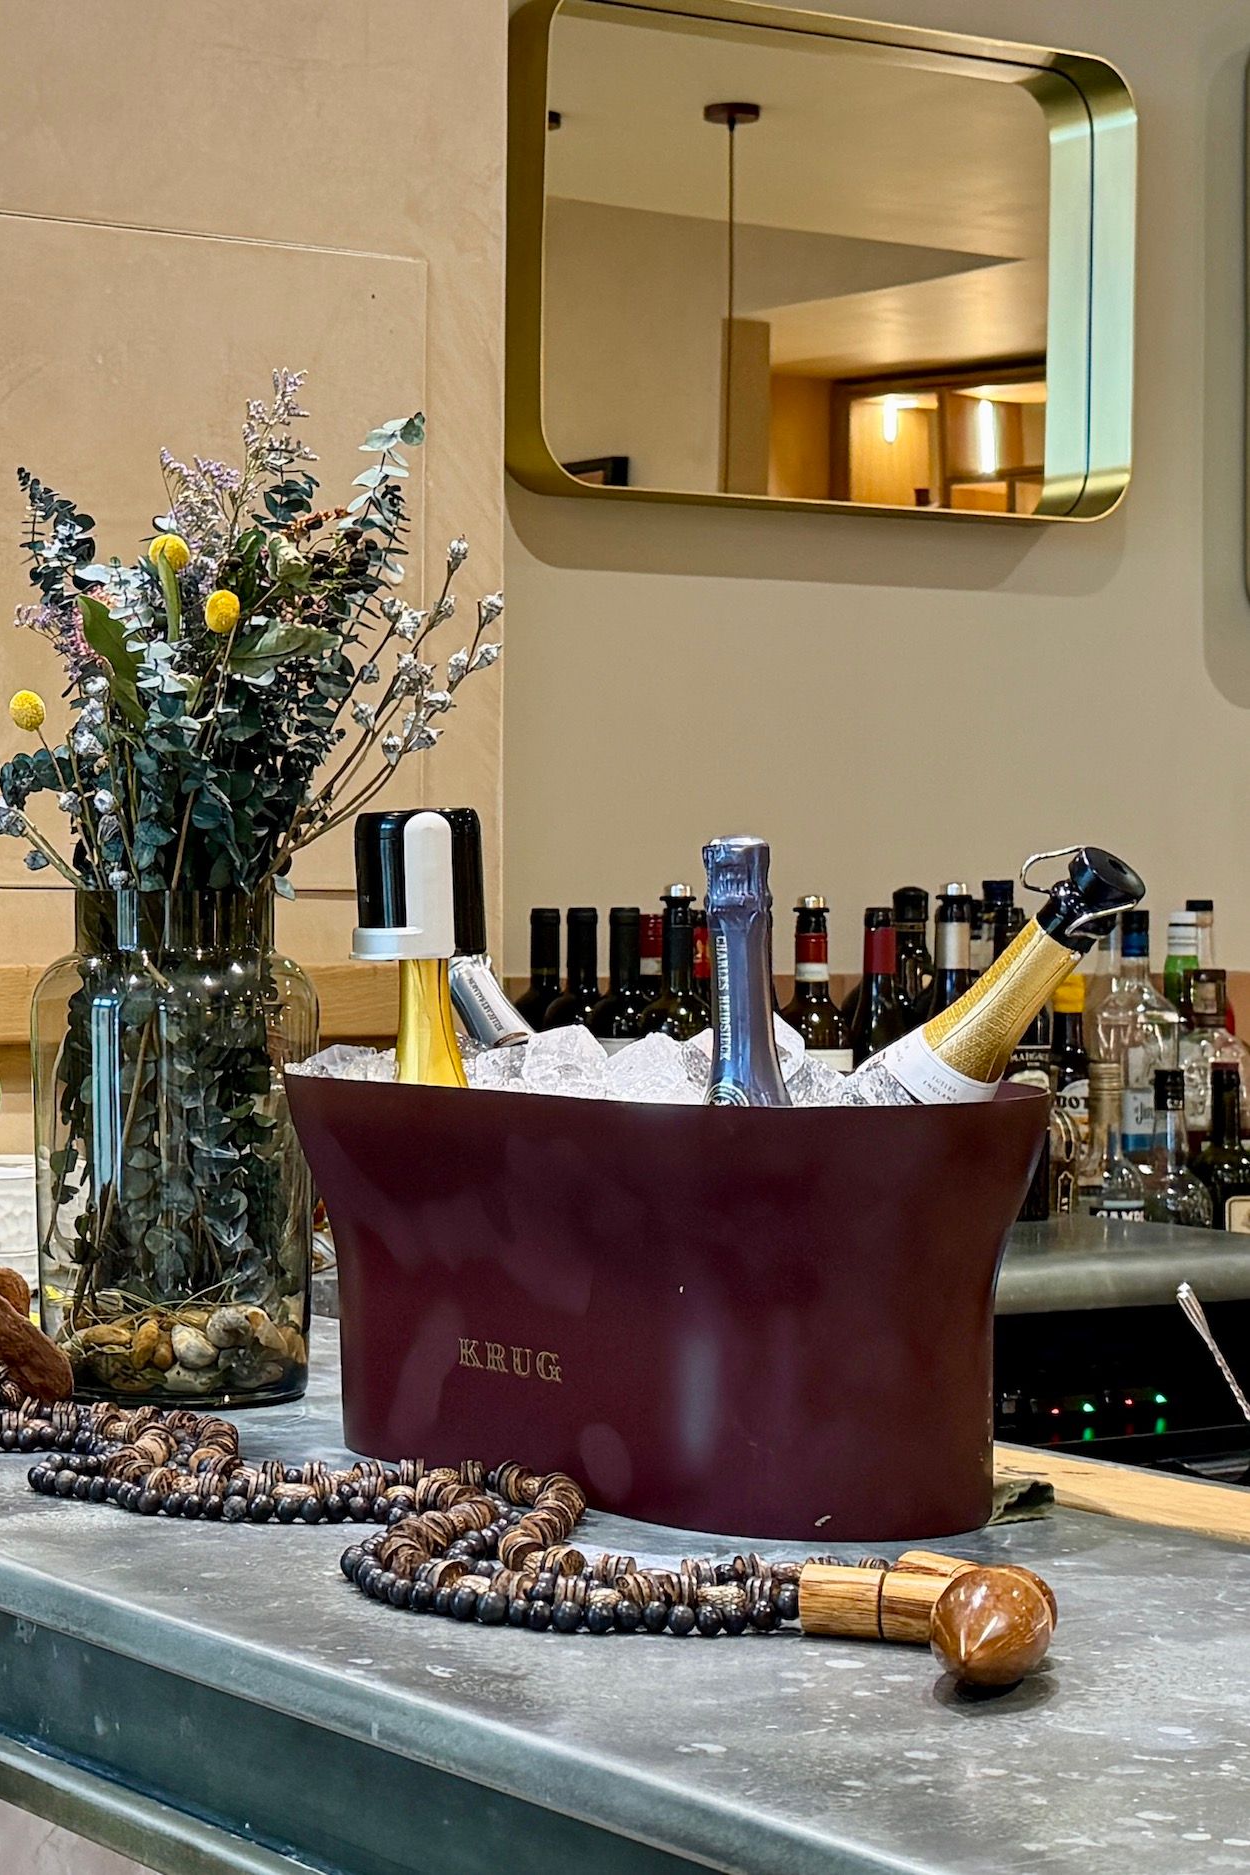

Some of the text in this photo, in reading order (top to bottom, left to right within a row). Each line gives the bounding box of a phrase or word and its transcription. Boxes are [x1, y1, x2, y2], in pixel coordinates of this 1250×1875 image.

[716, 935, 732, 1061] CHARLES HEIDSIECK
[458, 1337, 563, 1384] KRUG
